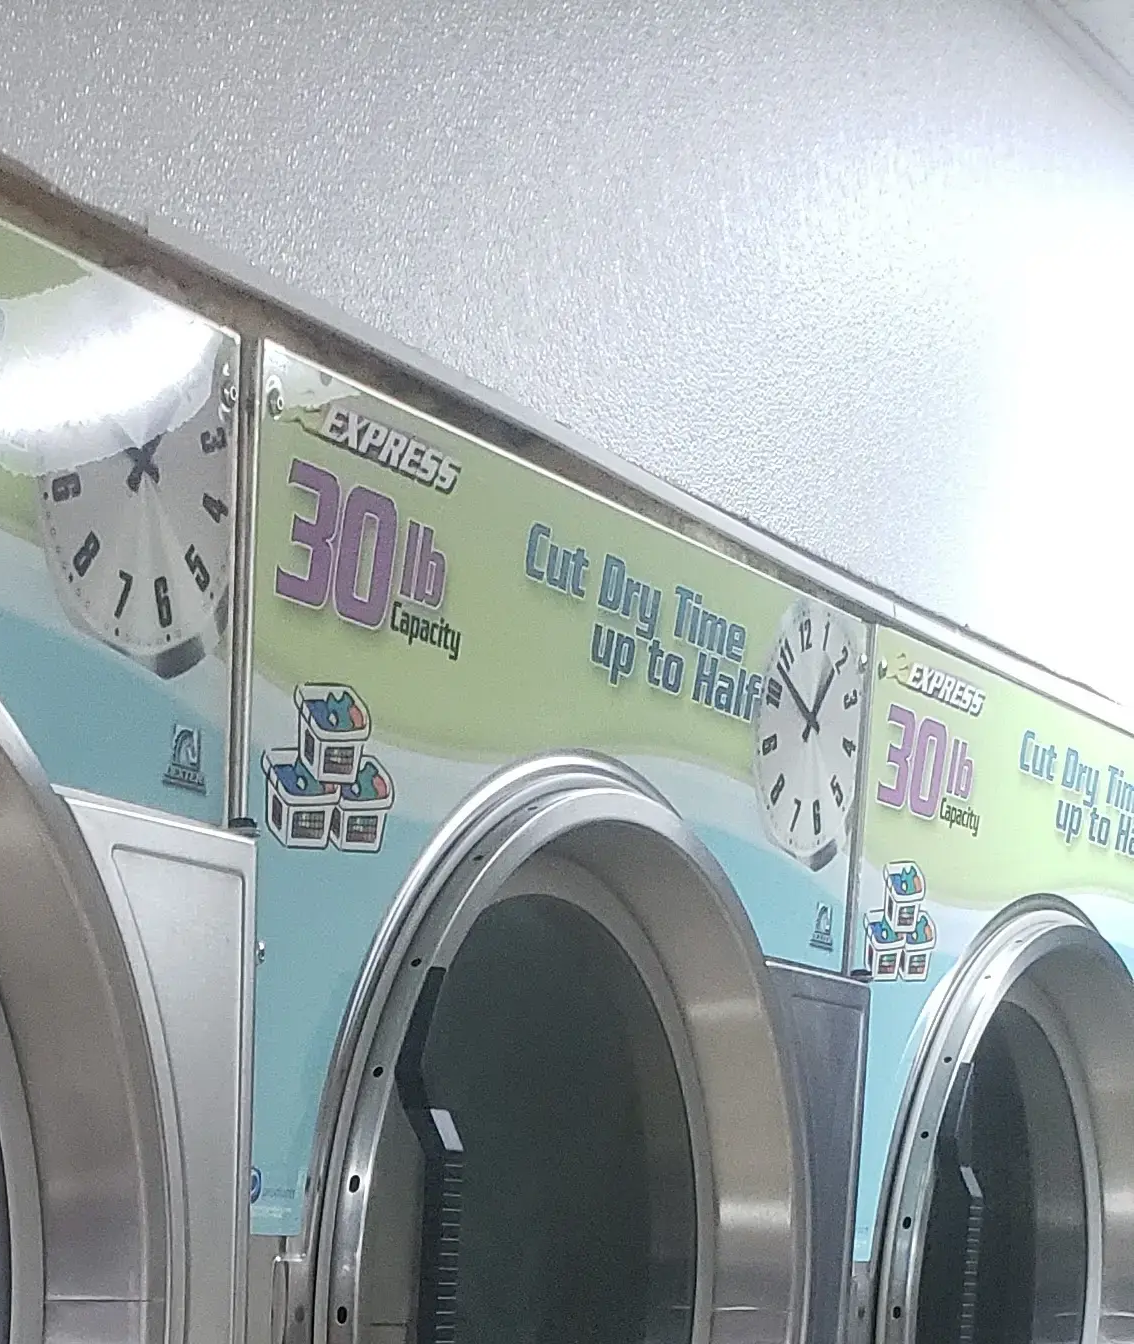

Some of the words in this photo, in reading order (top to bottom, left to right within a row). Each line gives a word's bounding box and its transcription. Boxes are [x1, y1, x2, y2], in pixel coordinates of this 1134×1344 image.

[321, 404, 462, 494] EXPRESS
[185, 544, 210, 592] 5
[274, 458, 398, 630] 30
[398, 519, 446, 610] lb
[114, 570, 133, 618] 7
[154, 576, 172, 628] 6
[525, 520, 590, 600] Cut
[598, 552, 662, 641] Dry
[673, 584, 746, 664] Time
[390, 602, 460, 661] Capacity
[590, 622, 636, 688] up
[646, 638, 685, 696] to
[692, 650, 764, 724] Half
[908, 662, 986, 716] EXPRESS
[876, 702, 948, 820] 30
[946, 736, 974, 801] lb
[1019, 729, 1058, 784] Cut
[1061, 747, 1100, 808] Dry
[939, 797, 981, 837] Capacity
[1056, 800, 1082, 844] up
[1088, 807, 1111, 847] to
